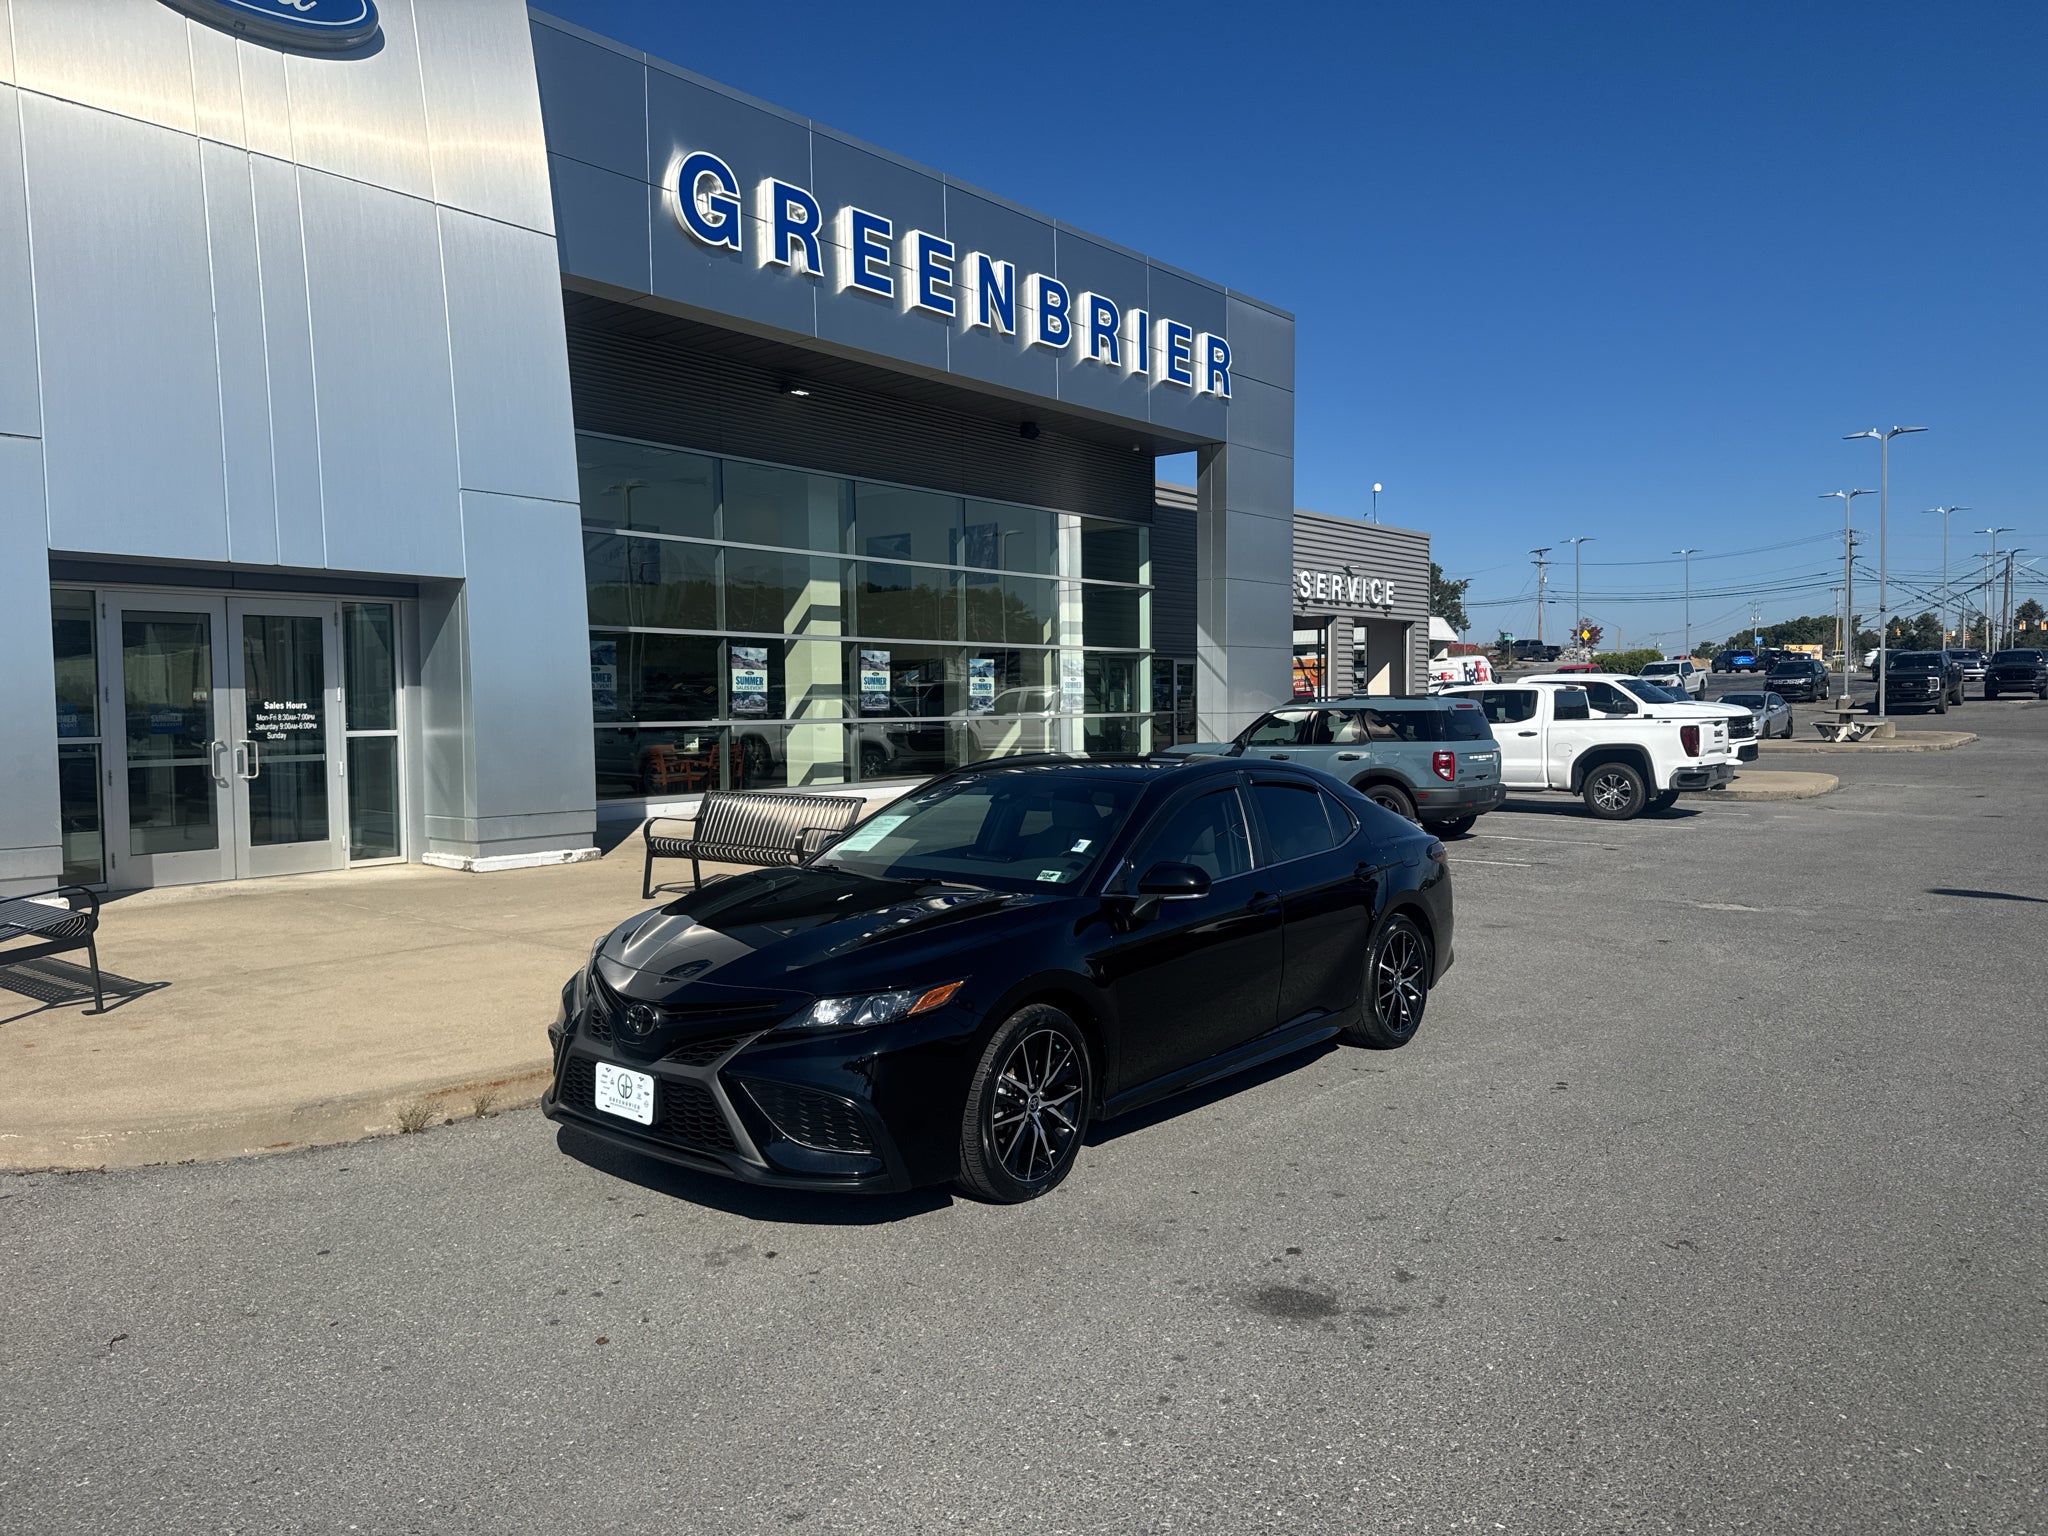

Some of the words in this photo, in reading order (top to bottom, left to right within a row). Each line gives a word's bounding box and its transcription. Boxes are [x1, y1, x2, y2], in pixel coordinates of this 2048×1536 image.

[672, 149, 1233, 399] GREENBRIER
[1300, 570, 1395, 605] SERVICE
[1429, 672, 1454, 681] FedEx
[1462, 661, 1489, 683] FedEx
[735, 675, 764, 686] SUMMER
[863, 676, 887, 686] SUMMER
[972, 682, 992, 691] SUMMER
[264, 701, 285, 710] Sales
[285, 701, 307, 710] Hours
[256, 713, 277, 721] Mon-Fri
[255, 722, 279, 731] Saturday
[266, 731, 287, 740] Sunday
